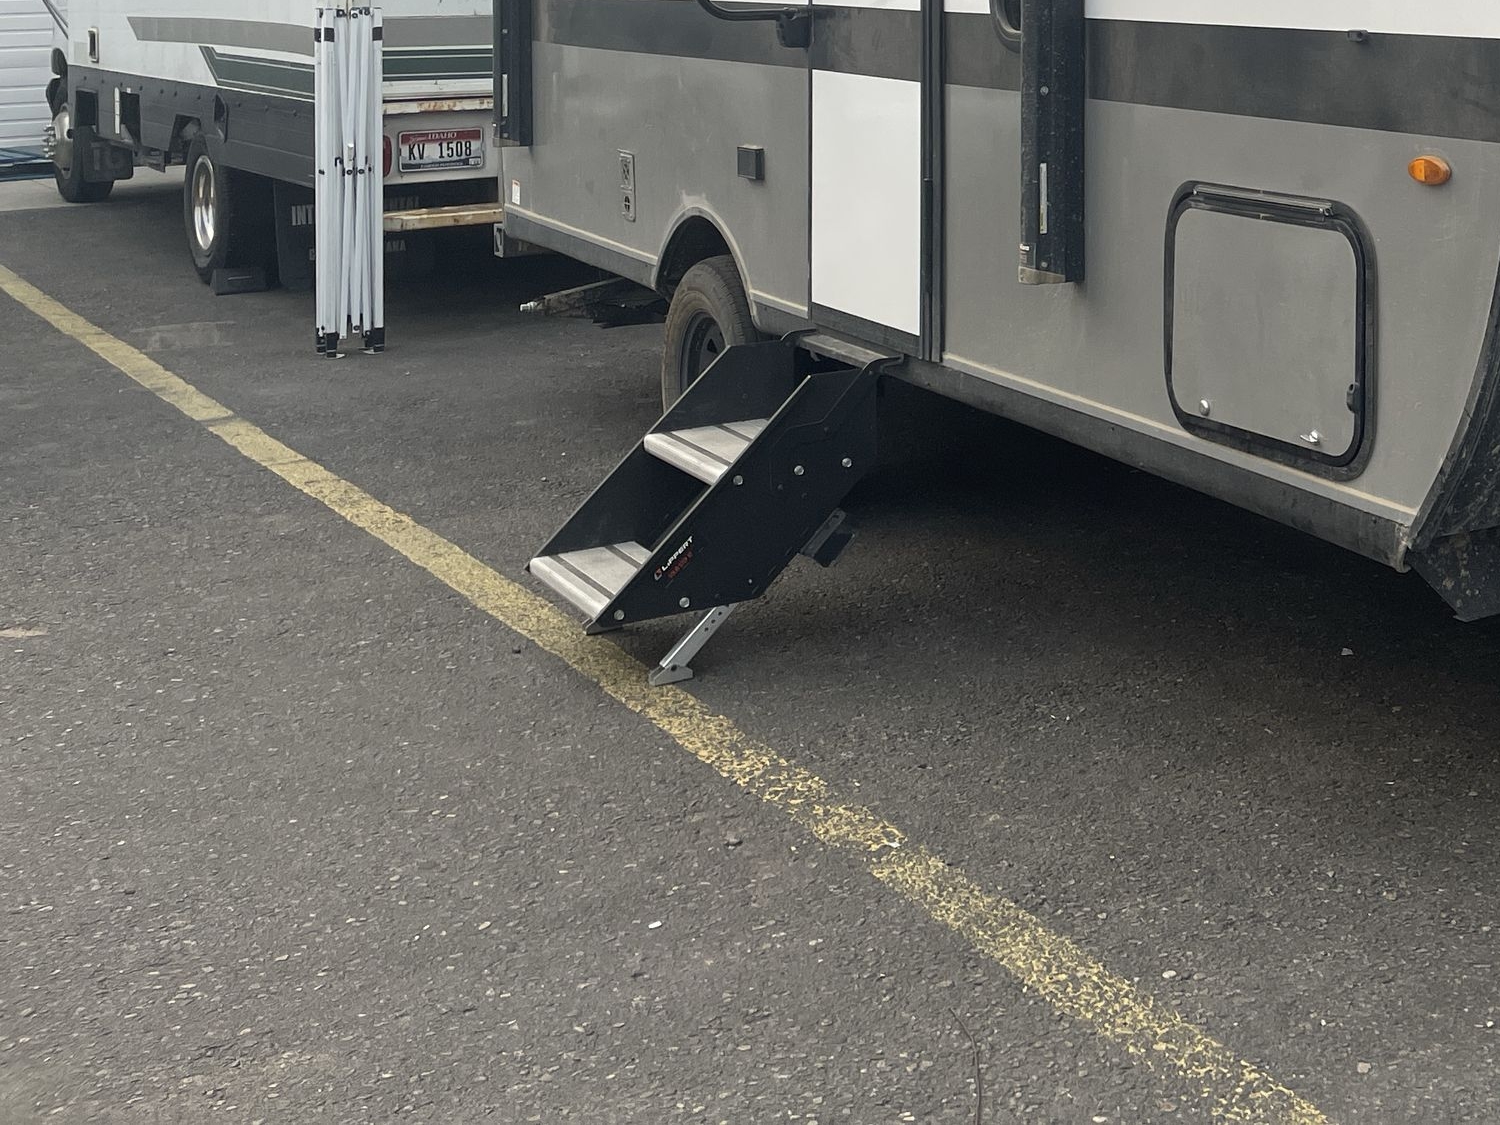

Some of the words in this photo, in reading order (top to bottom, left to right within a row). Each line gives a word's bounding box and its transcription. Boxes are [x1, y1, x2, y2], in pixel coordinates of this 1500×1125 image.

[428, 132, 457, 140] IDAHO
[408, 142, 425, 161] KV
[438, 140, 472, 159] 1508
